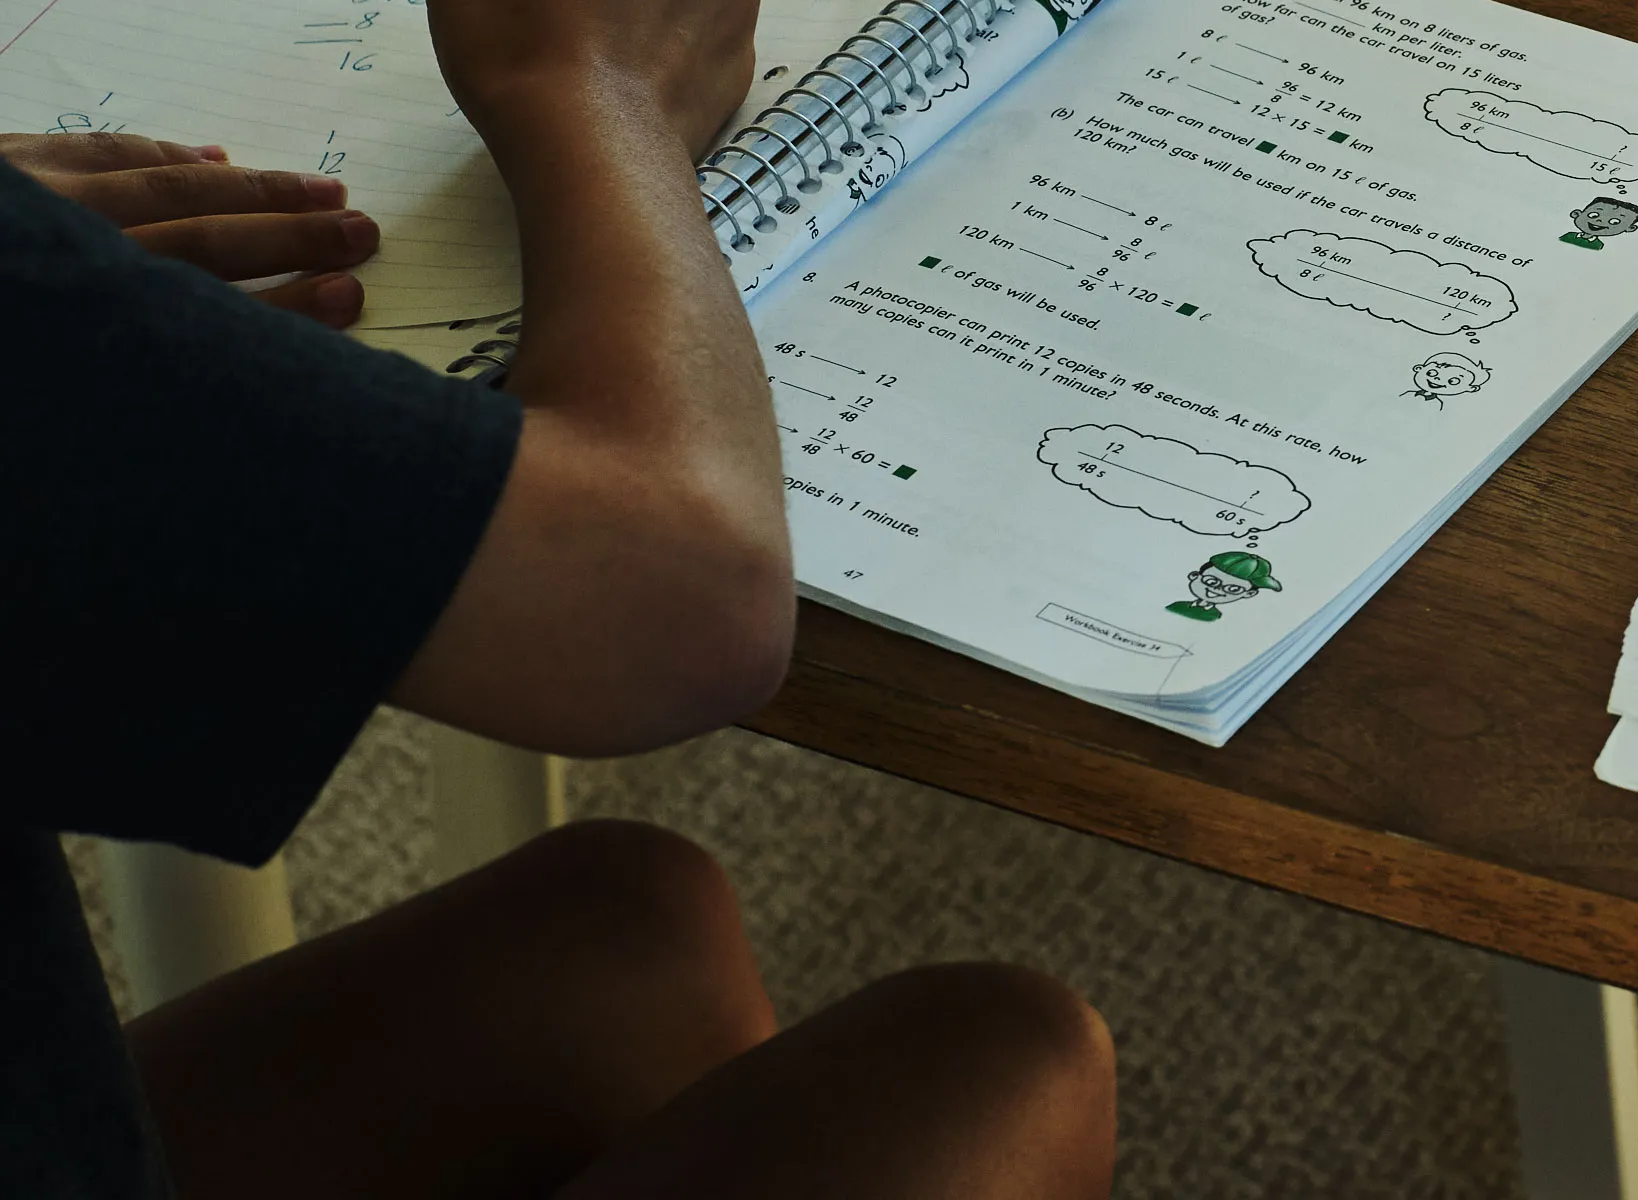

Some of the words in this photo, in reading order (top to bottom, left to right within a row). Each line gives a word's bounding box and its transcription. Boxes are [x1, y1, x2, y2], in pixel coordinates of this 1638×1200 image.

[1220, 4, 1243, 14] of
[1236, 9, 1276, 25] gas?
[1370, 5, 1396, 21] km
[1398, 17, 1420, 29] on
[1422, 22, 1437, 33] 8
[1436, 26, 1476, 46] liters
[1478, 42, 1501, 52] of
[1495, 47, 1527, 62] gas.
[339, 50, 373, 72] 16
[1272, 3, 1297, 17] far
[1299, 14, 1327, 29] can
[1329, 24, 1356, 39] the
[1358, 35, 1386, 48] car
[1387, 44, 1435, 64] travel
[1434, 60, 1456, 72] on
[1461, 66, 1482, 78] 15
[1482, 71, 1522, 91] liters
[1370, 21, 1397, 37] km
[1395, 33, 1428, 46] per
[1428, 40, 1462, 59] liter.
[842, 279, 860, 292] A
[857, 285, 957, 320] photocopier
[957, 317, 987, 333] can
[985, 329, 1031, 351] print
[1032, 344, 1056, 360] 12
[1056, 356, 1108, 380] copies
[1108, 373, 1127, 387] in
[1130, 380, 1155, 394] 48
[1153, 390, 1219, 419] seconds.
[1223, 412, 1249, 428] At
[1251, 421, 1282, 438] this
[1284, 433, 1322, 453] rate,
[1327, 444, 1368, 465] how
[783, 476, 825, 498] opies
[825, 491, 844, 506] in
[848, 500, 861, 511] 1
[861, 508, 919, 538] minute.
[842, 568, 864, 580] 47
